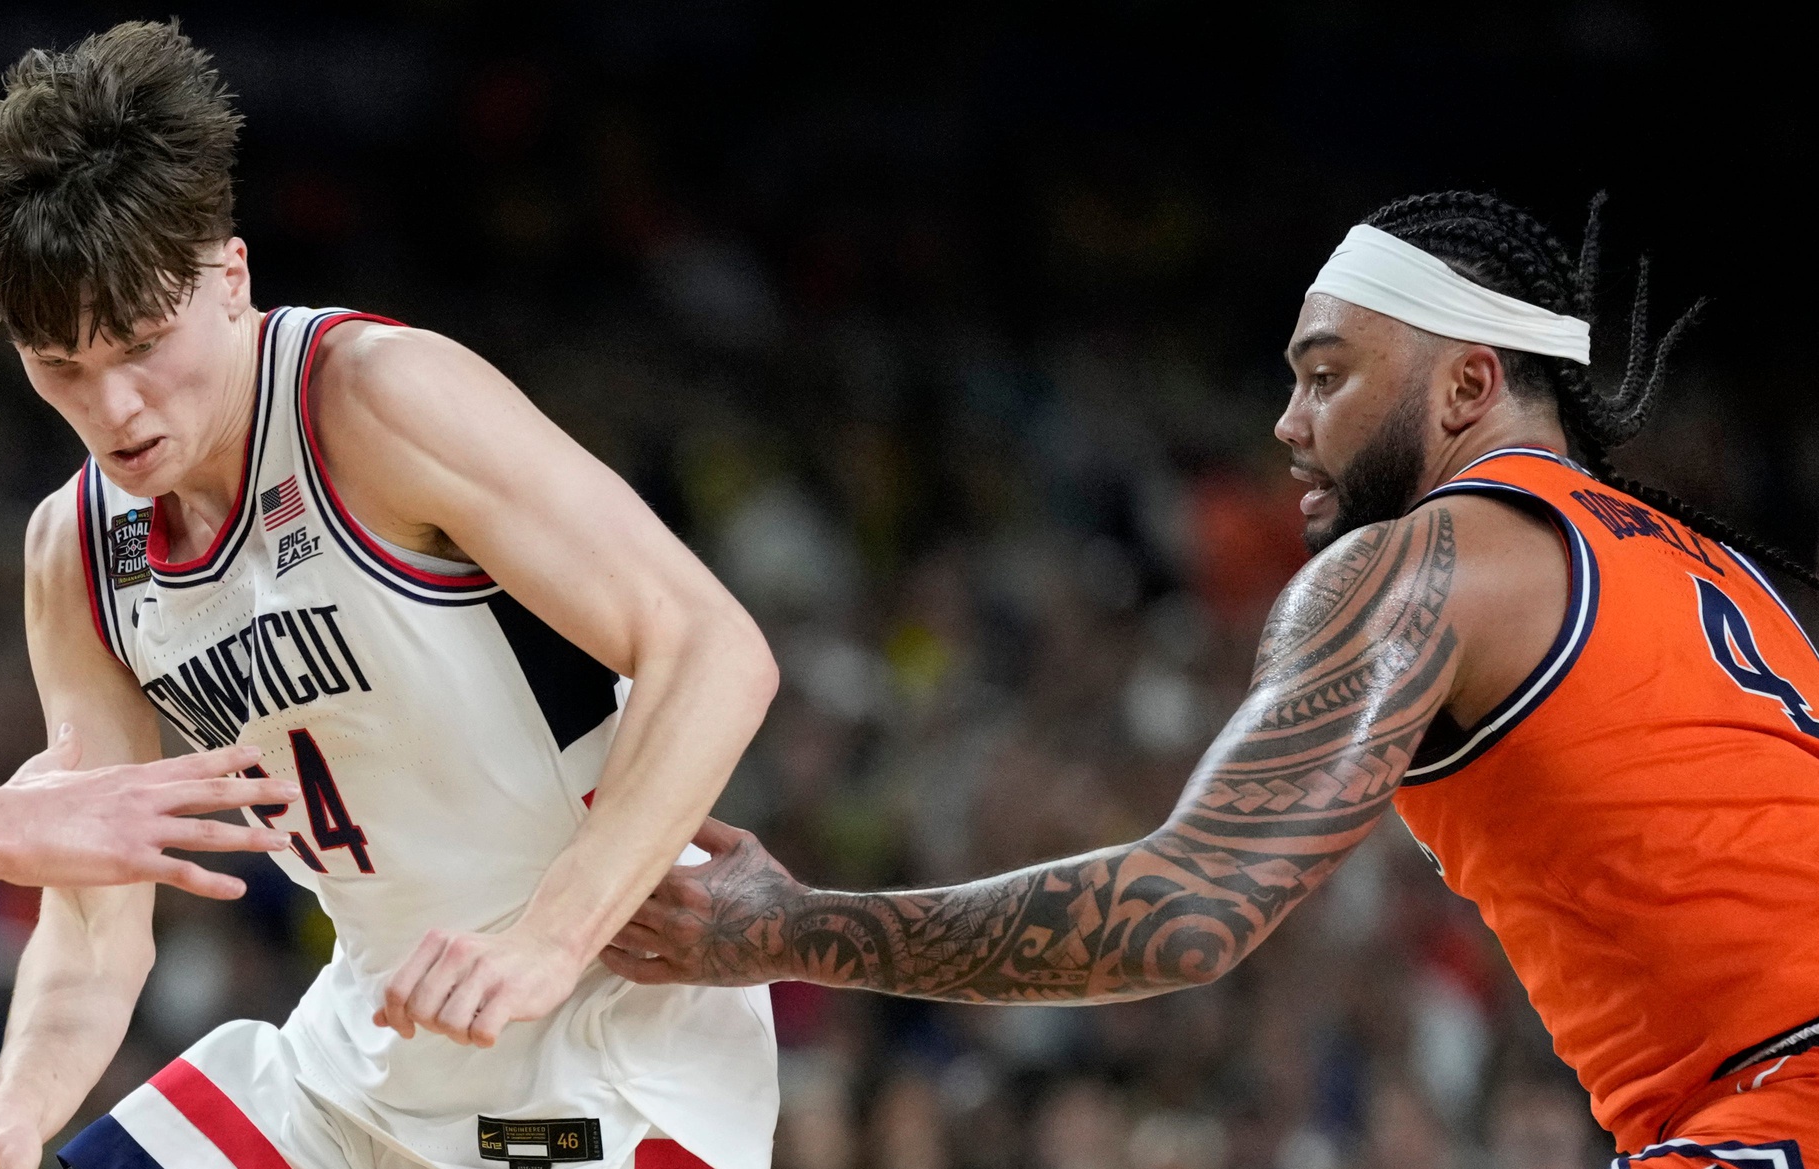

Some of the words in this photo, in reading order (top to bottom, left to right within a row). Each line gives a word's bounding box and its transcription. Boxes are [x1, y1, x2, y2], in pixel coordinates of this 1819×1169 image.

[115, 522, 149, 543] FINAL
[279, 526, 307, 554] BIG
[118, 554, 149, 574] FOUR
[277, 535, 321, 569] EAST
[1685, 567, 1819, 739] 4
[557, 1132, 579, 1149] 46
